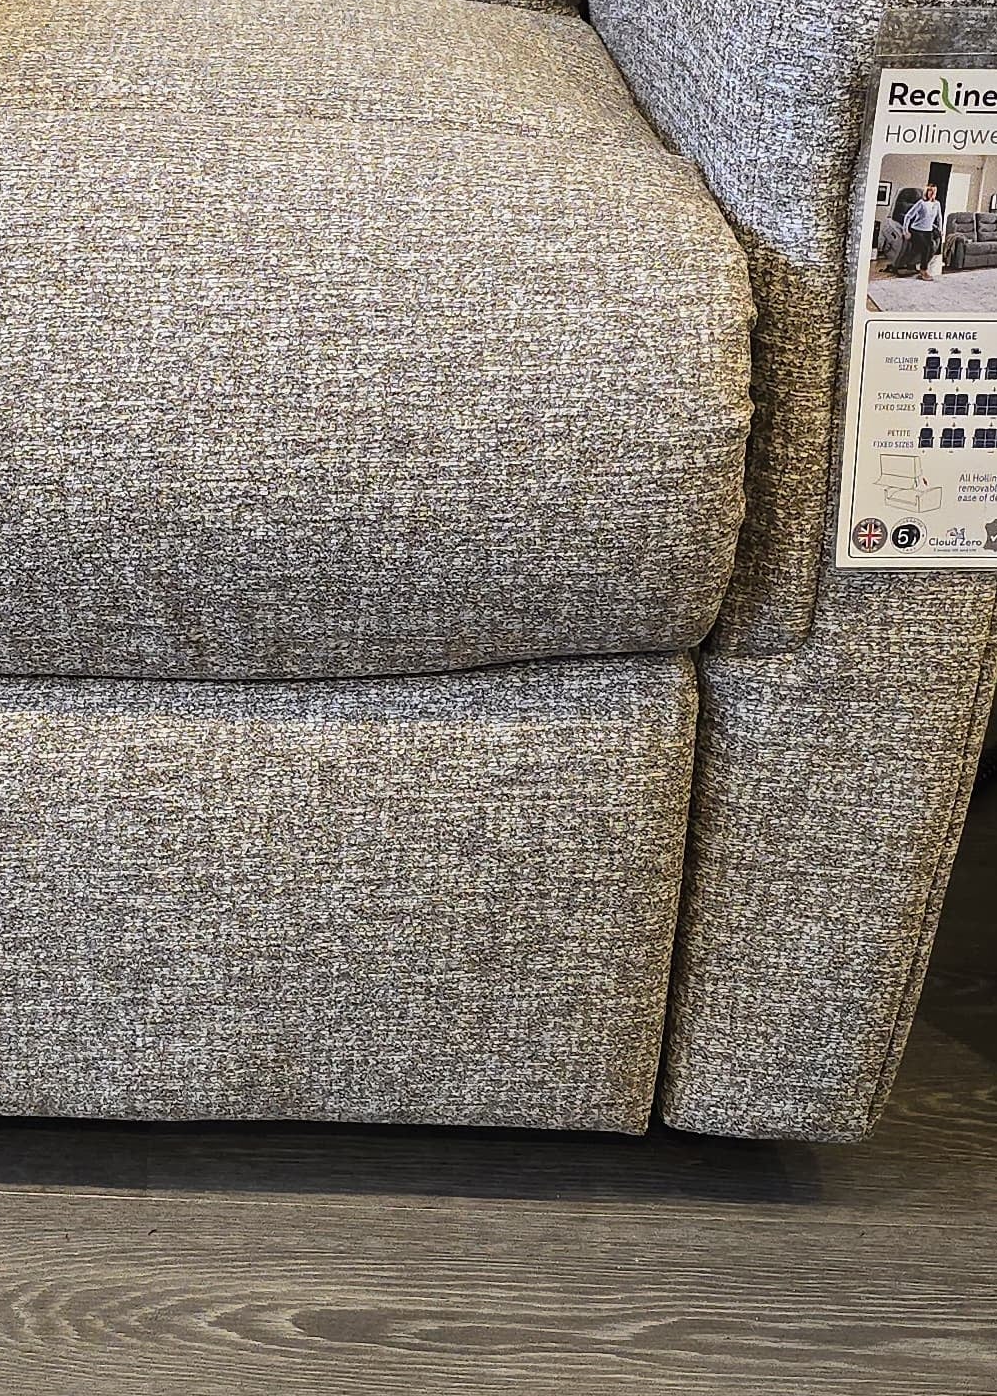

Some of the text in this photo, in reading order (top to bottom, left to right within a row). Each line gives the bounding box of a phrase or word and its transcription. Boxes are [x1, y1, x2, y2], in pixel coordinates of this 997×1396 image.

[877, 331, 978, 341] HOLLINGWELL RANGE
[959, 473, 971, 482] All
[979, 493, 988, 503] of
[928, 537, 982, 547] Cloud Zero
